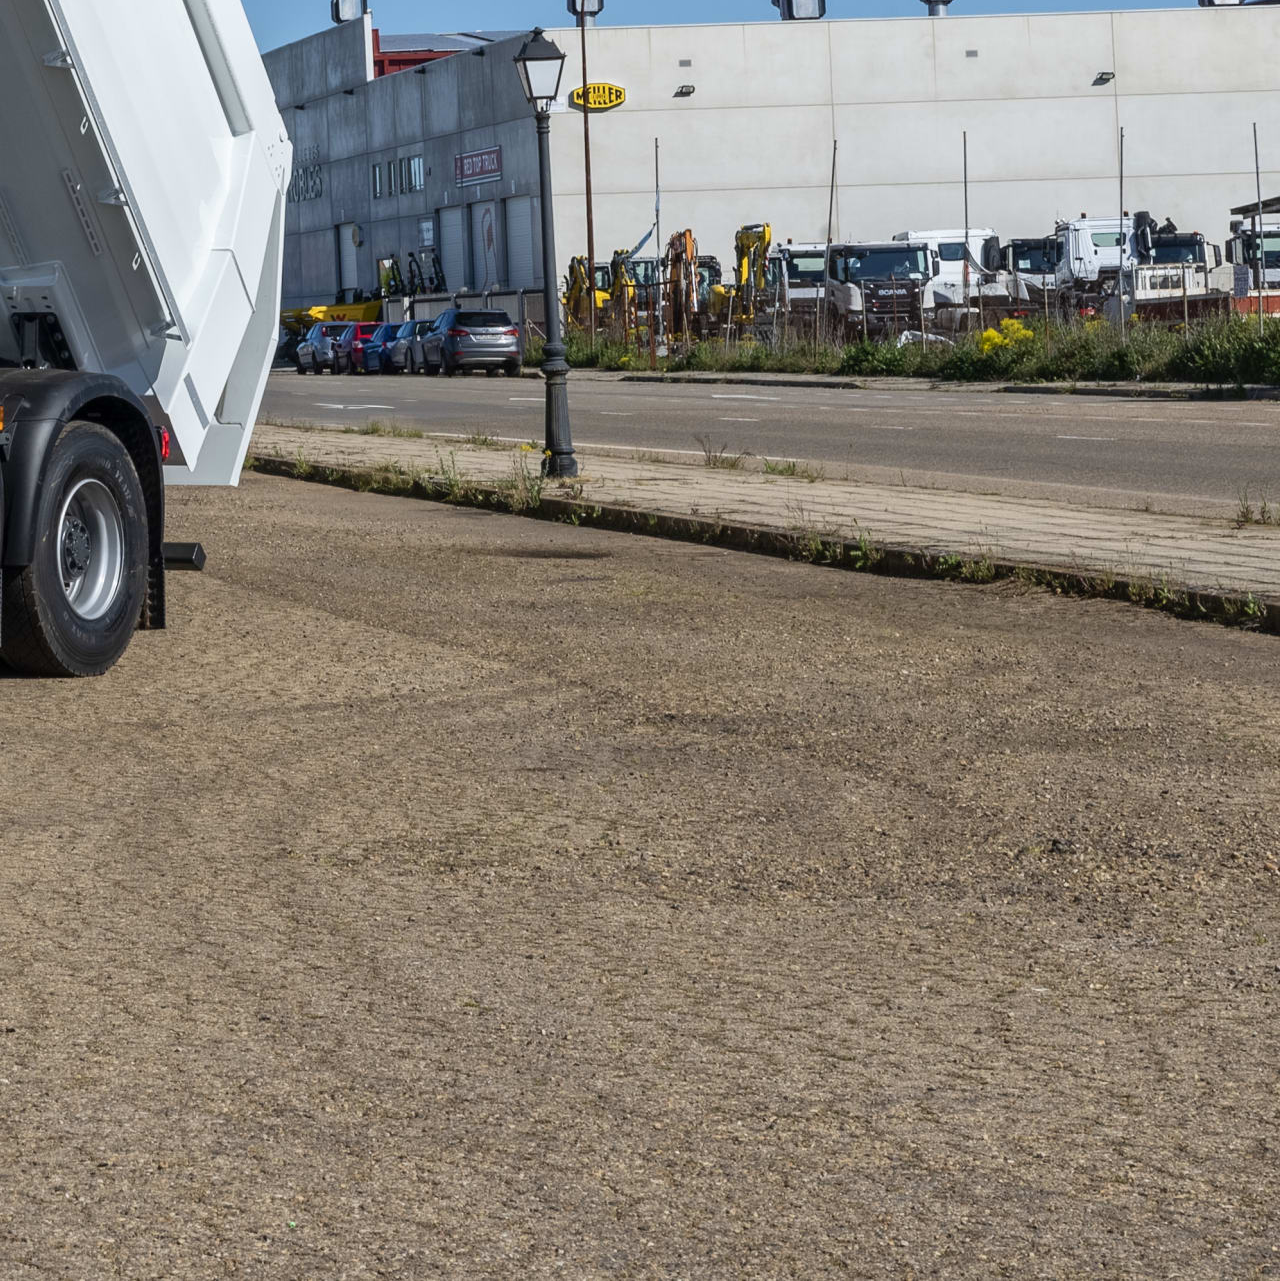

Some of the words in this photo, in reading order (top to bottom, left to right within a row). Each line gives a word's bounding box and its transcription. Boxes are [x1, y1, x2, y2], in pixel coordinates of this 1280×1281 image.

[463, 157, 473, 175] RED
[472, 155, 482, 173] TOP
[482, 153, 498, 171] TRUCK
